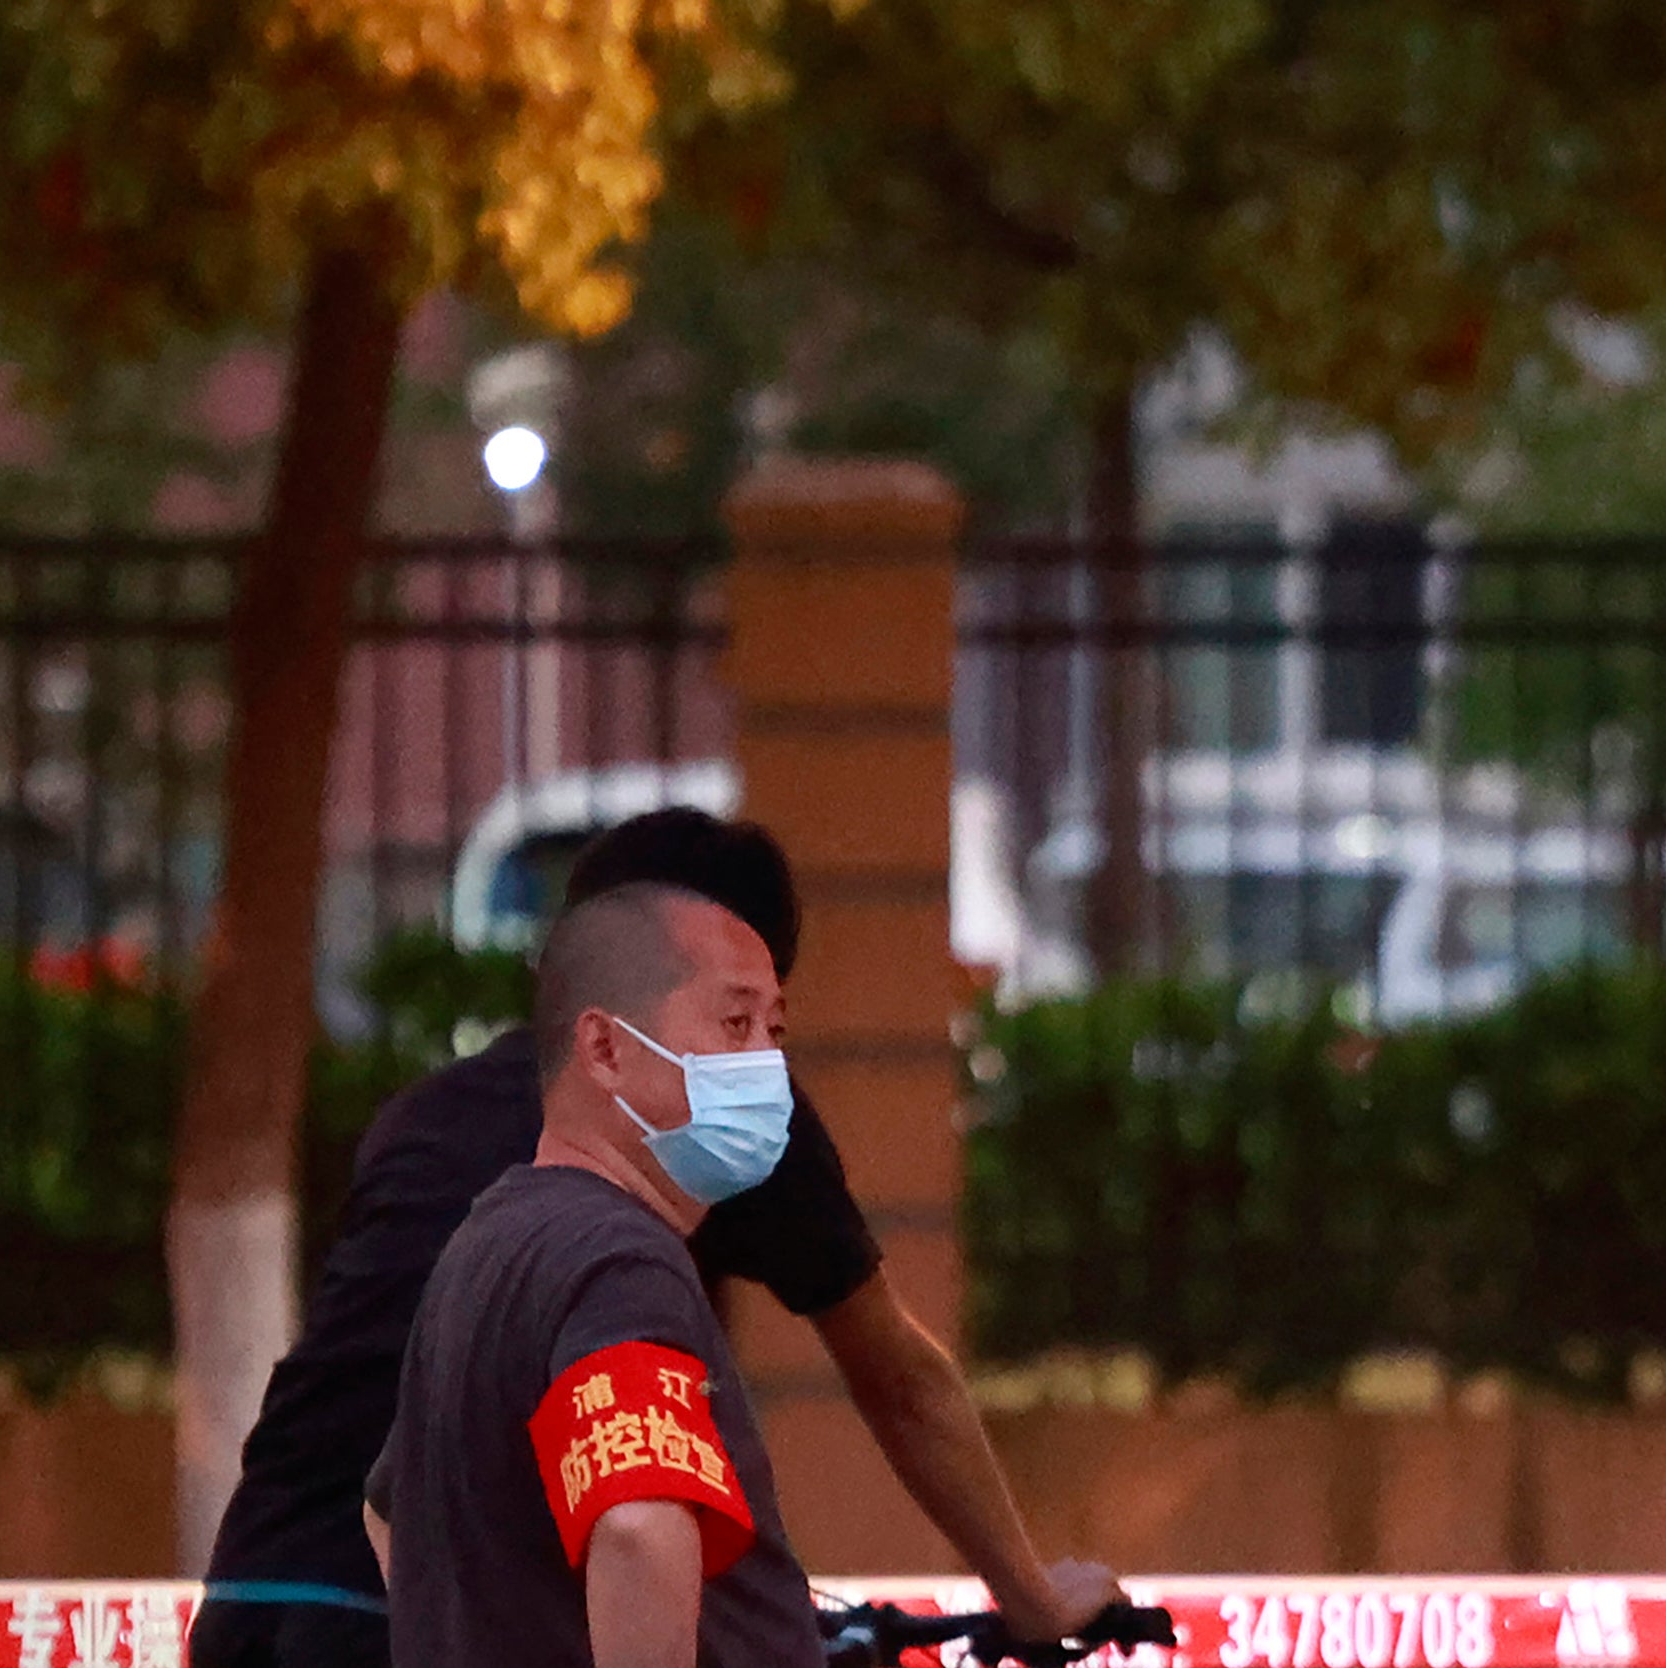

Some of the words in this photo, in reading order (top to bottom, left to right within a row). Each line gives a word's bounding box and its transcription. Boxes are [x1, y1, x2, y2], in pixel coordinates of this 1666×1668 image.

[572, 1366, 693, 1420] 浦江
[559, 1404, 732, 1514] 防控检查
